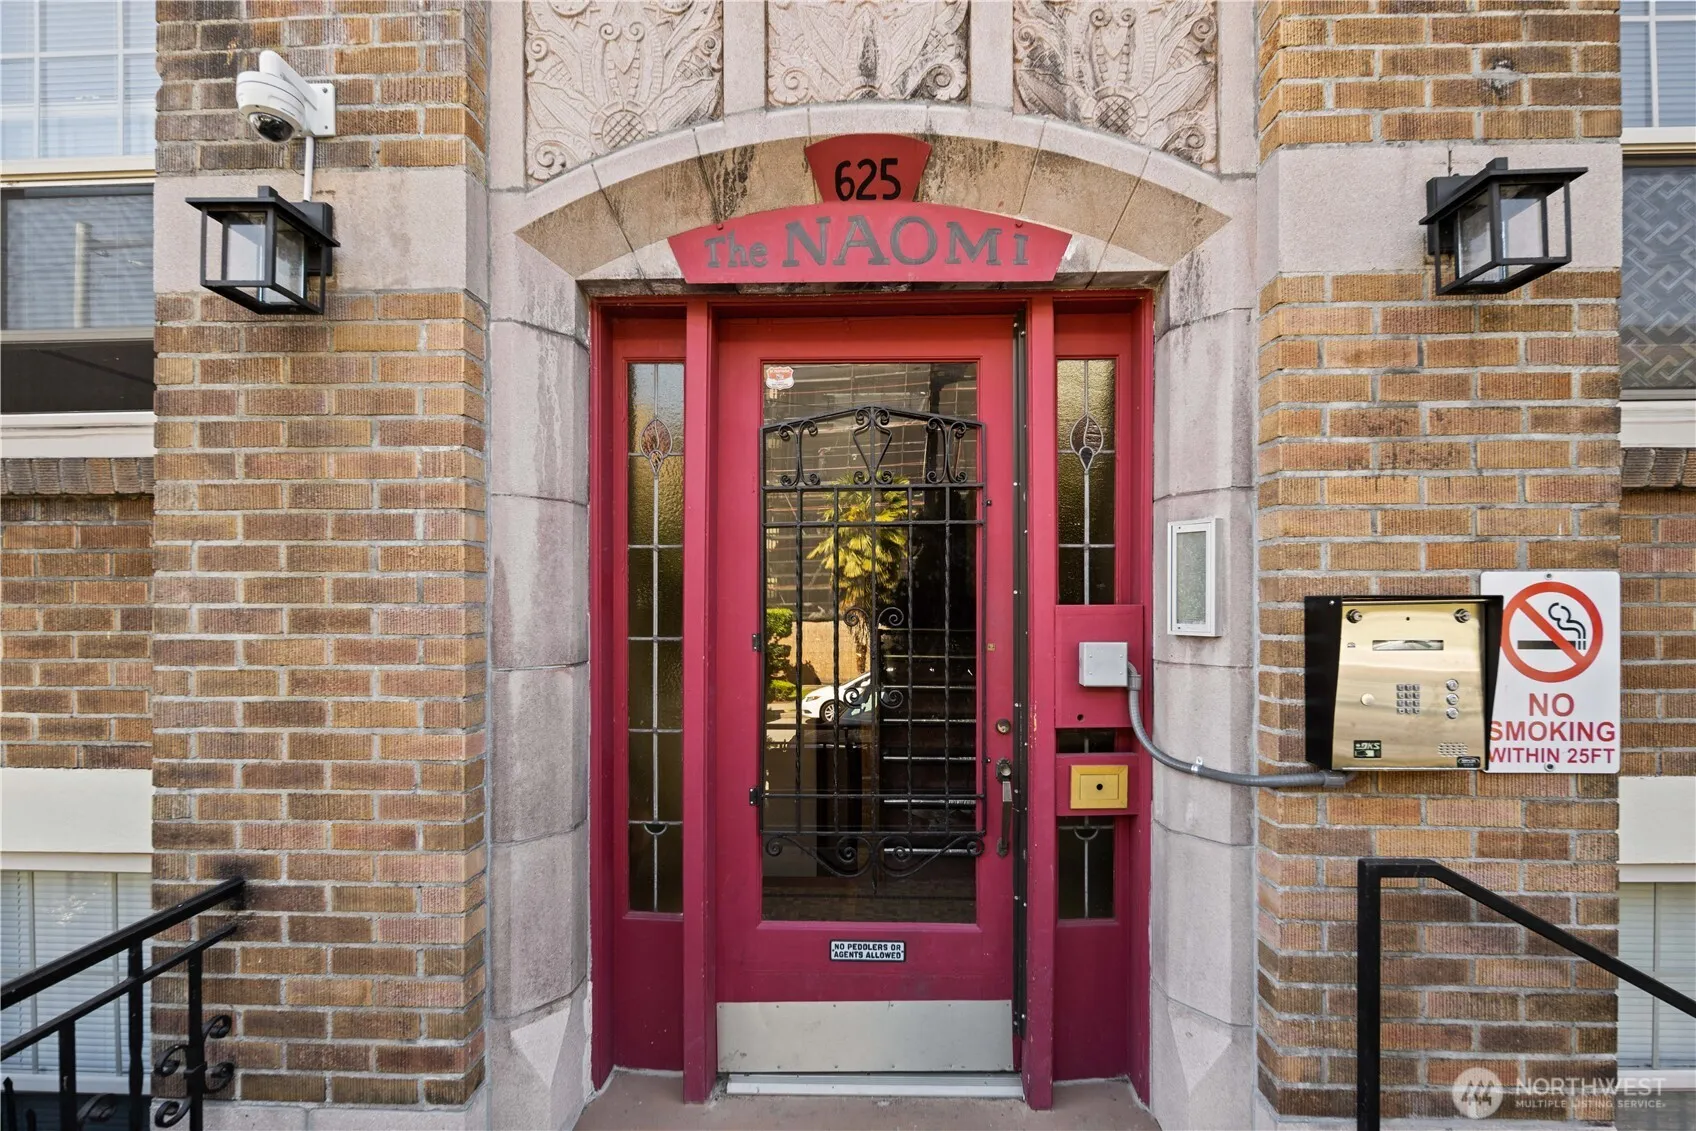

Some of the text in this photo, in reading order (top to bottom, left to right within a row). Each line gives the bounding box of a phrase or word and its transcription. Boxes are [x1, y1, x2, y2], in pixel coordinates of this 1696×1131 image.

[834, 157, 902, 201] 625
[703, 214, 1030, 268] The NAOMI
[1528, 692, 1575, 717] NO
[1490, 720, 1616, 742] SMOKING
[1489, 747, 1560, 764] WITHIN
[1566, 747, 1616, 764] 25FT
[833, 950, 901, 959] AGENTS ALLOWED
[834, 943, 901, 951] NO PEDDLERS OR
